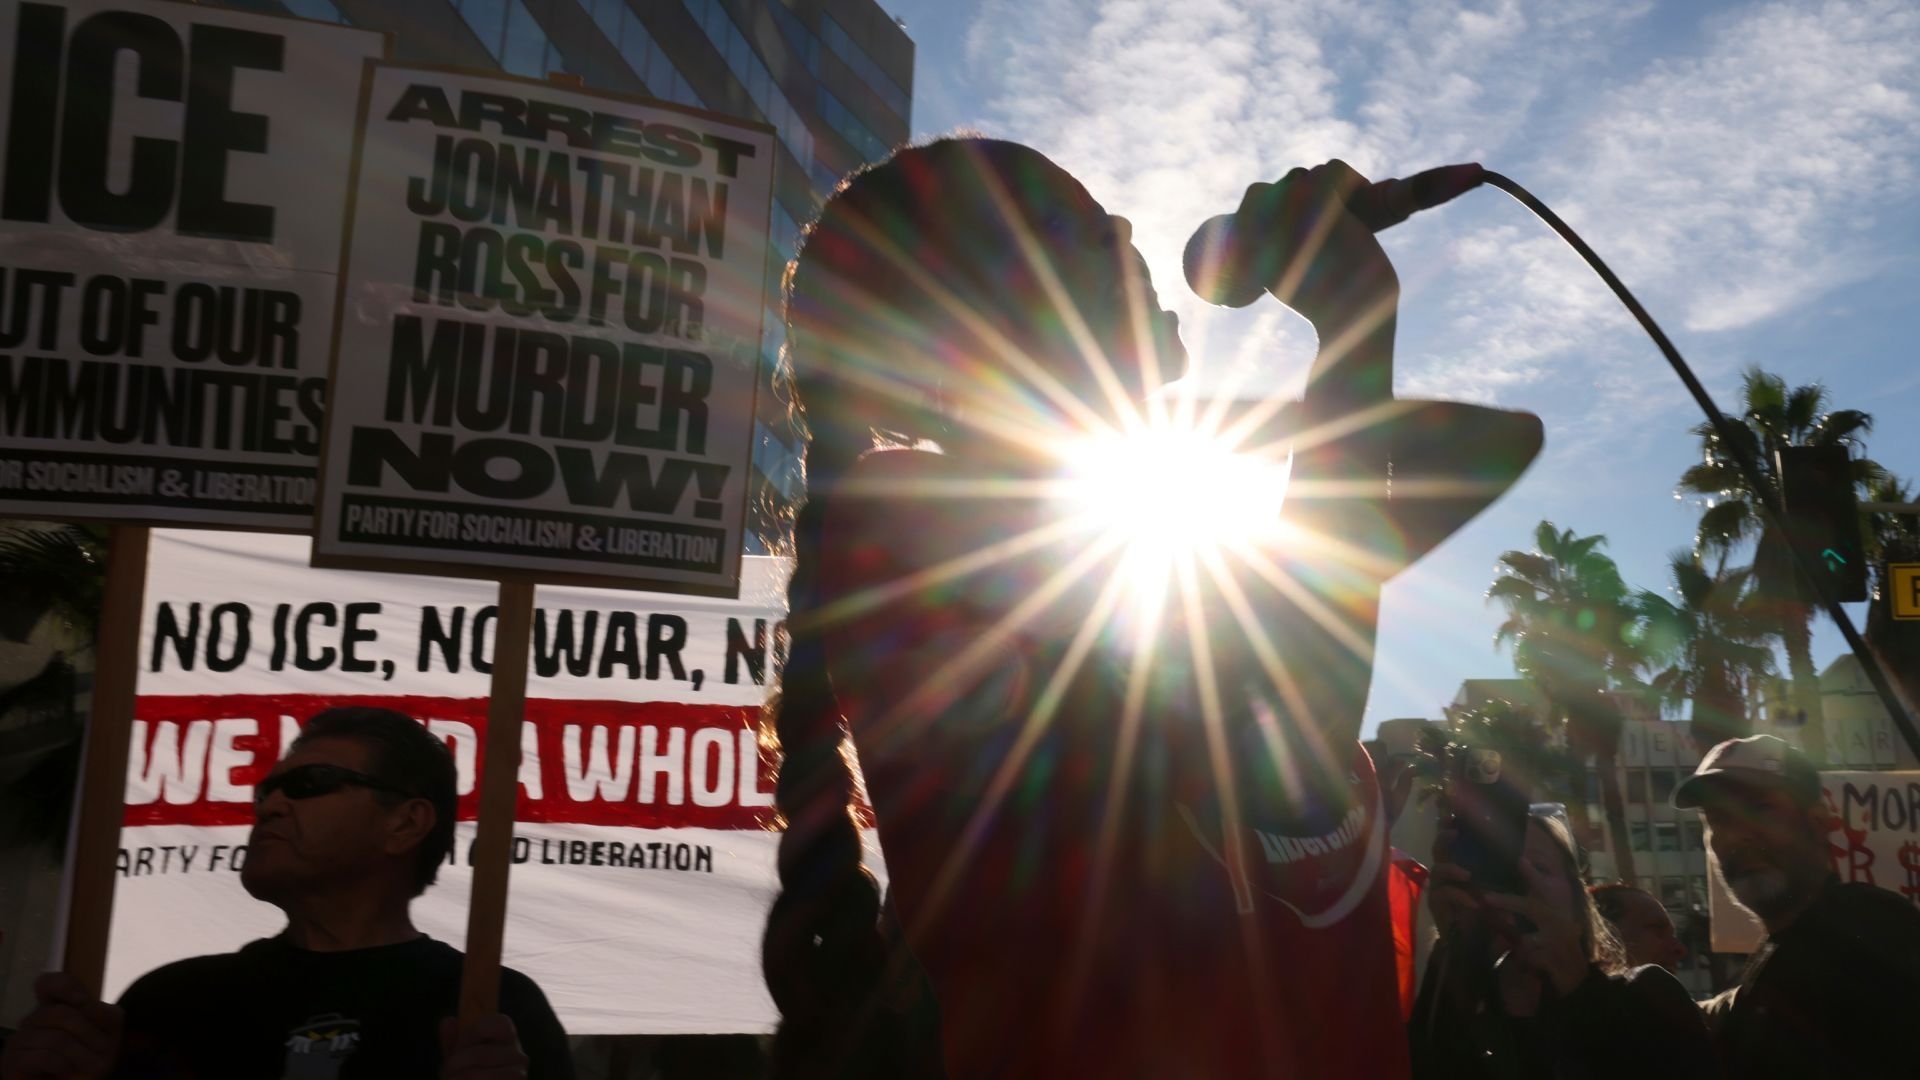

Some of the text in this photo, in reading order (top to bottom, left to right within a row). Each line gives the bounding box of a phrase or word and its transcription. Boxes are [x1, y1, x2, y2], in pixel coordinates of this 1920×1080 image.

[2, 2, 285, 244] ICE
[385, 83, 756, 179] ARREST
[406, 135, 728, 259] JONATHAN
[0, 266, 302, 369] UT OF OUR
[412, 220, 708, 339] ROSS FOR
[0, 356, 326, 457] MMUNITIES
[384, 314, 714, 455] MURDER
[0, 458, 24, 490] OR
[27, 461, 155, 496] SOCIALISM
[157, 468, 190, 499] &
[347, 426, 732, 521] NOW!
[346, 504, 718, 565] PARTY FOR SOCIALISM & LIBERATION
[150, 602, 251, 674] NO
[271, 602, 394, 681] ICE,
[534, 607, 704, 691] WAR,
[124, 718, 258, 805] WE
[563, 724, 776, 807] WHOL
[115, 845, 198, 878] ARTY
[208, 845, 249, 872] FO
[542, 839, 713, 873] LIBERATION
